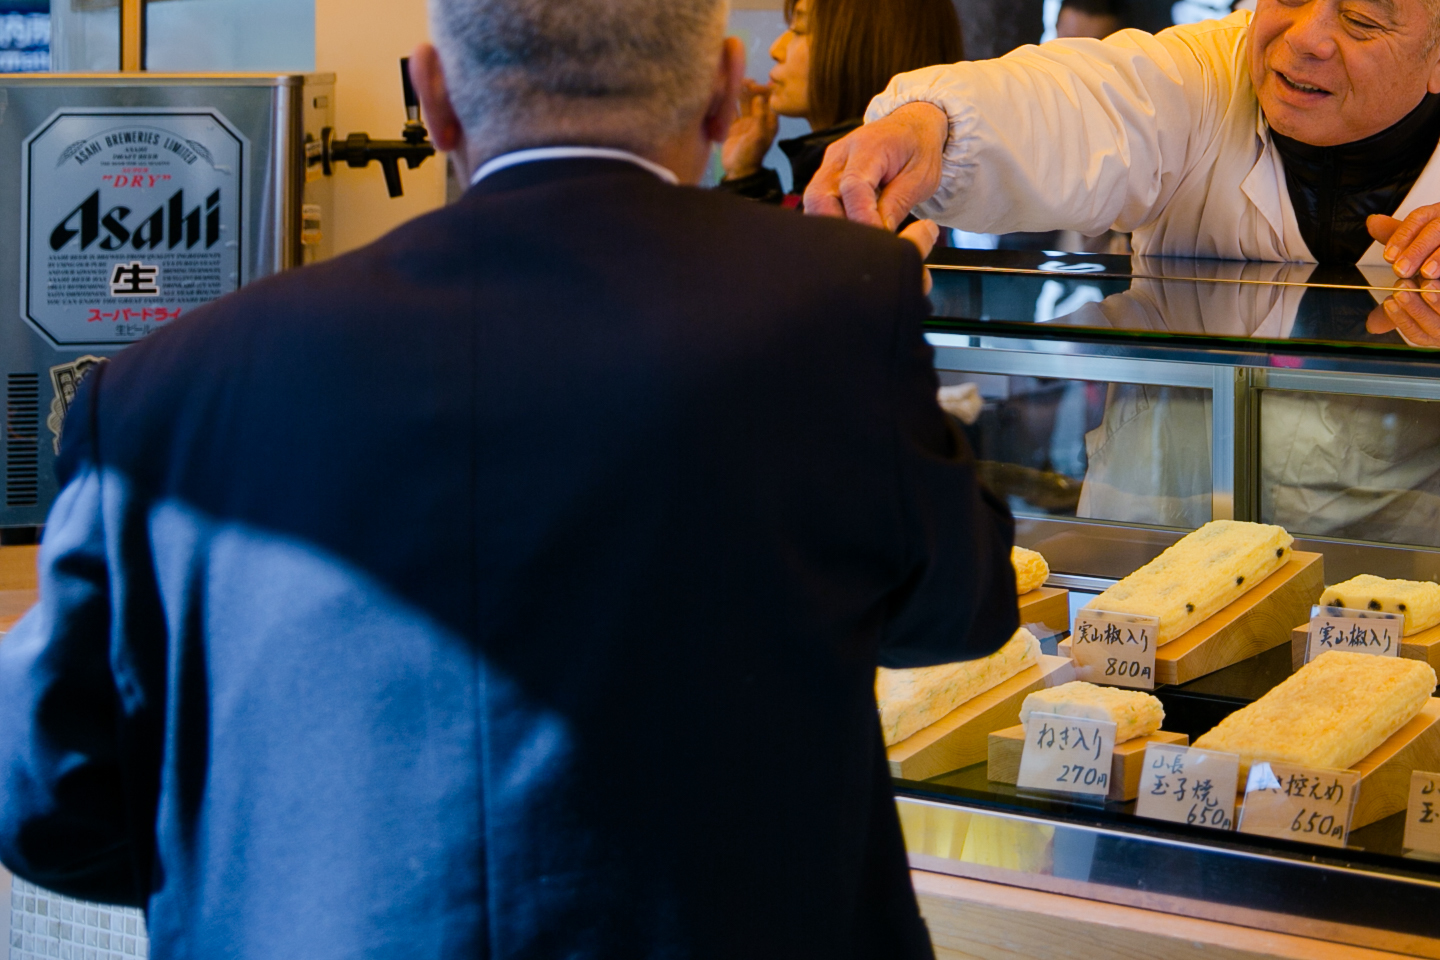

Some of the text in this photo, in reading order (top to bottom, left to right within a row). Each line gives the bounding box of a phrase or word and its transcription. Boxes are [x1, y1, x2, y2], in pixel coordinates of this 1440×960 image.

[74, 131, 198, 166] ASAHI BREWERIES LIMITED
[49, 187, 221, 252] Asahi
[113, 263, 157, 295] 生
[87, 307, 183, 322] スーパードライ
[1075, 620, 1148, 653] 実山椒入り
[1318, 622, 1391, 653] 実山椒入り
[1105, 657, 1151, 679] 800円
[1038, 723, 1103, 761] ねぎ入り
[1056, 765, 1107, 788] 270円
[1151, 775, 1219, 808] 玉子焼
[1291, 809, 1344, 840] 650円
